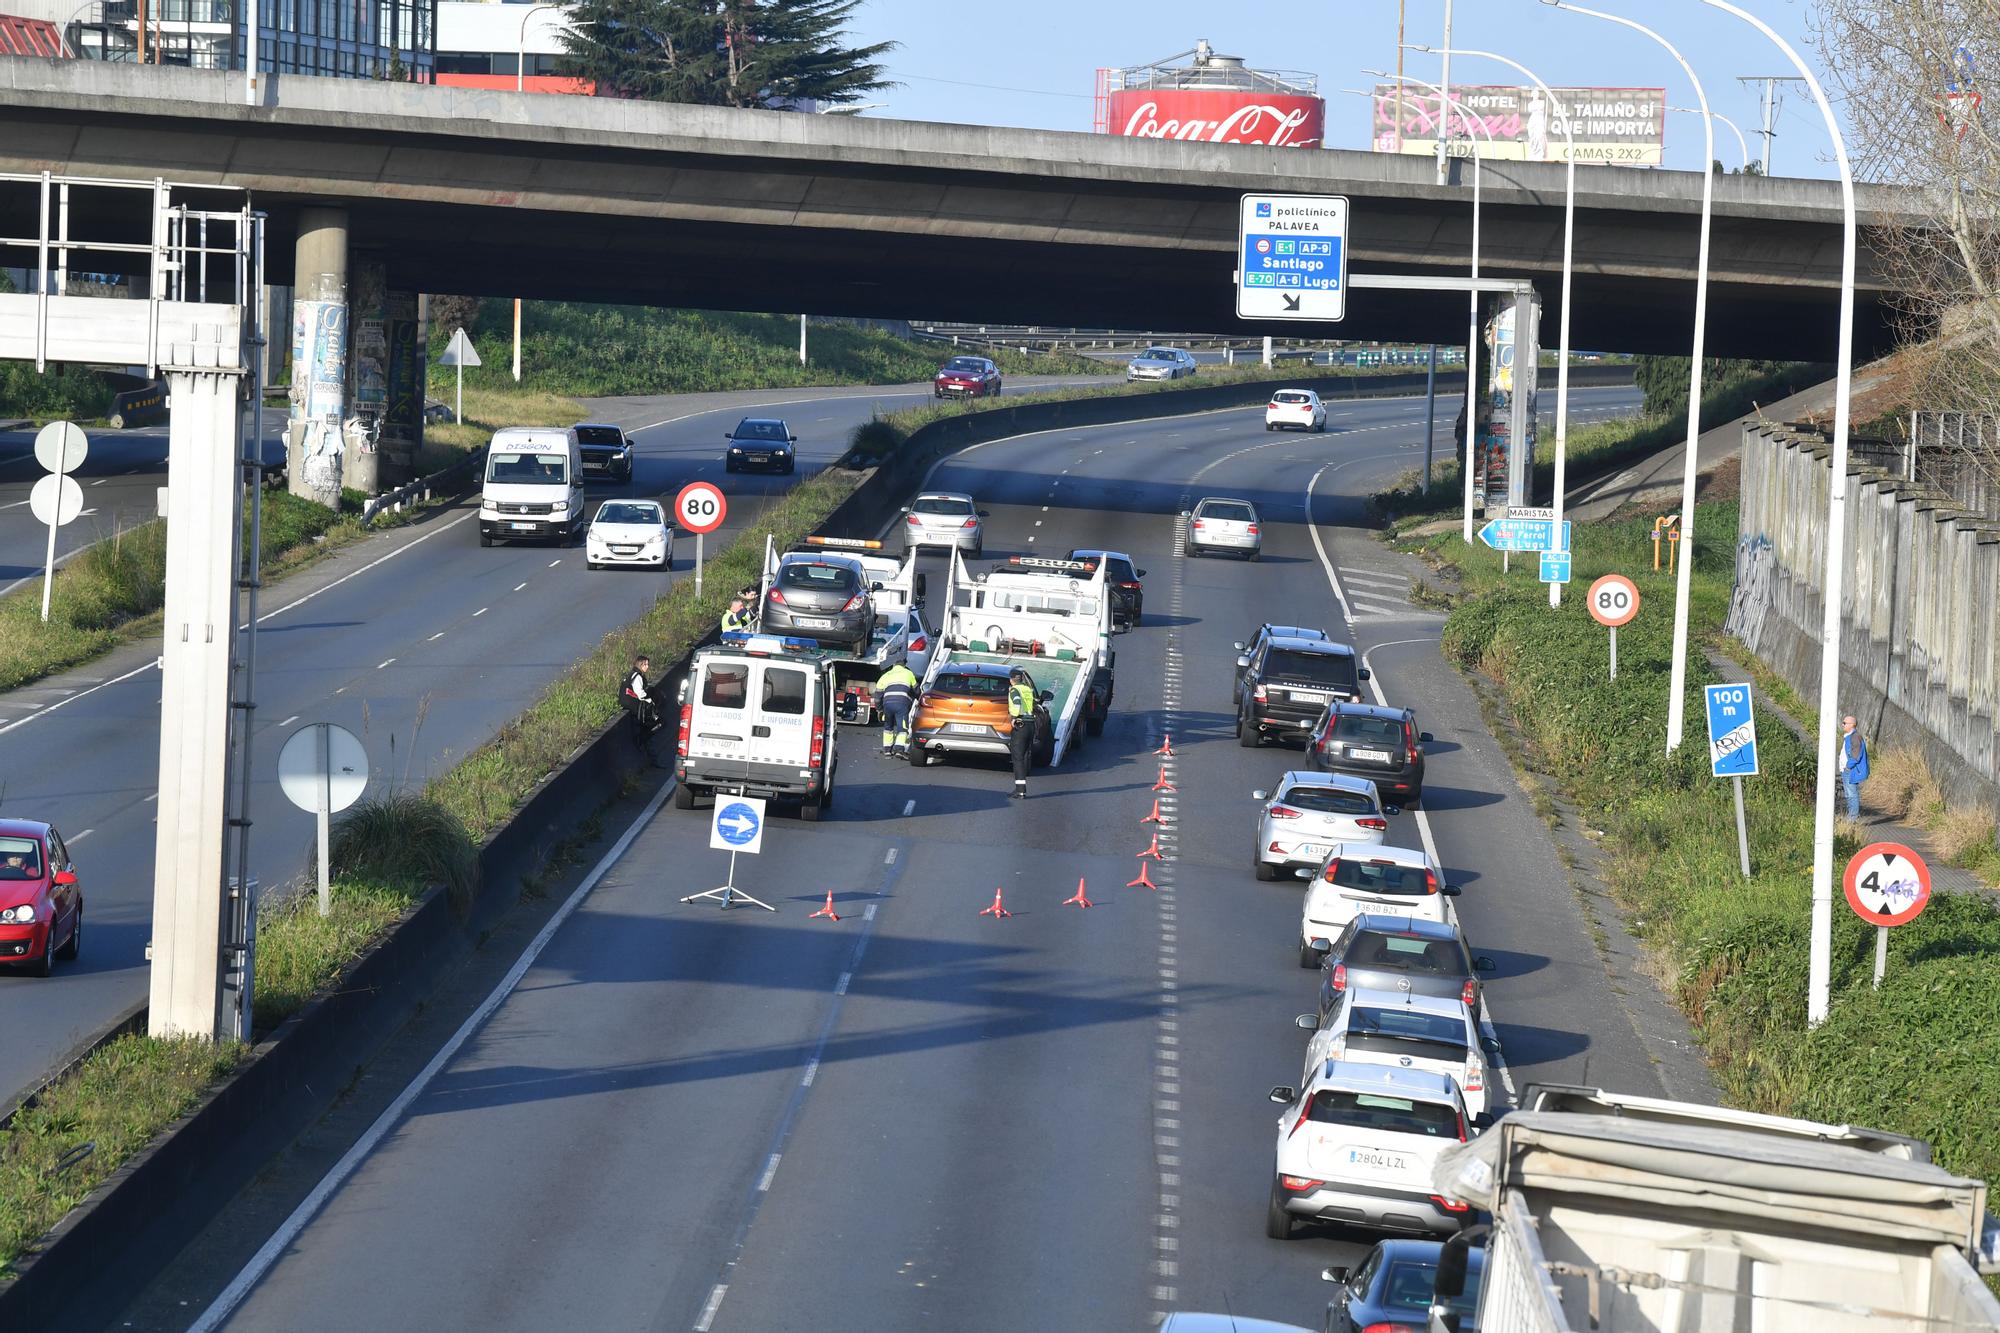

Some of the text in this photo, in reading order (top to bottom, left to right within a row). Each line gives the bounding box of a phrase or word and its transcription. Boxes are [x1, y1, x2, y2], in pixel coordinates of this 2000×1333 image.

[1468, 96, 1518, 108] HOTEL
[1552, 101, 1655, 118] EL TAMAÑO SÍ
[1122, 102, 1309, 145] Coca-Cl
[1551, 121, 1656, 136] QUE IMPORTA
[1563, 148, 1642, 159] CAMAS 2X2
[1277, 207, 1337, 217] policlínico
[1269, 221, 1319, 230] PALAVEA
[1277, 242, 1293, 251] E-1
[1301, 243, 1329, 253] AP-9
[1262, 256, 1324, 271] Santiago
[1248, 274, 1338, 289] E-70 A-6 Lugo
[687, 499, 715, 516] 80
[1509, 509, 1554, 518] MARISTAS
[1551, 570, 1559, 579] 3
[1599, 592, 1629, 609] 80
[1713, 690, 1744, 705] 100
[1723, 705, 1736, 716] m
[767, 716, 803, 726] INFORMES
[1360, 903, 1382, 913] 3630
[1357, 1153, 1406, 1169] 2804 LZL
